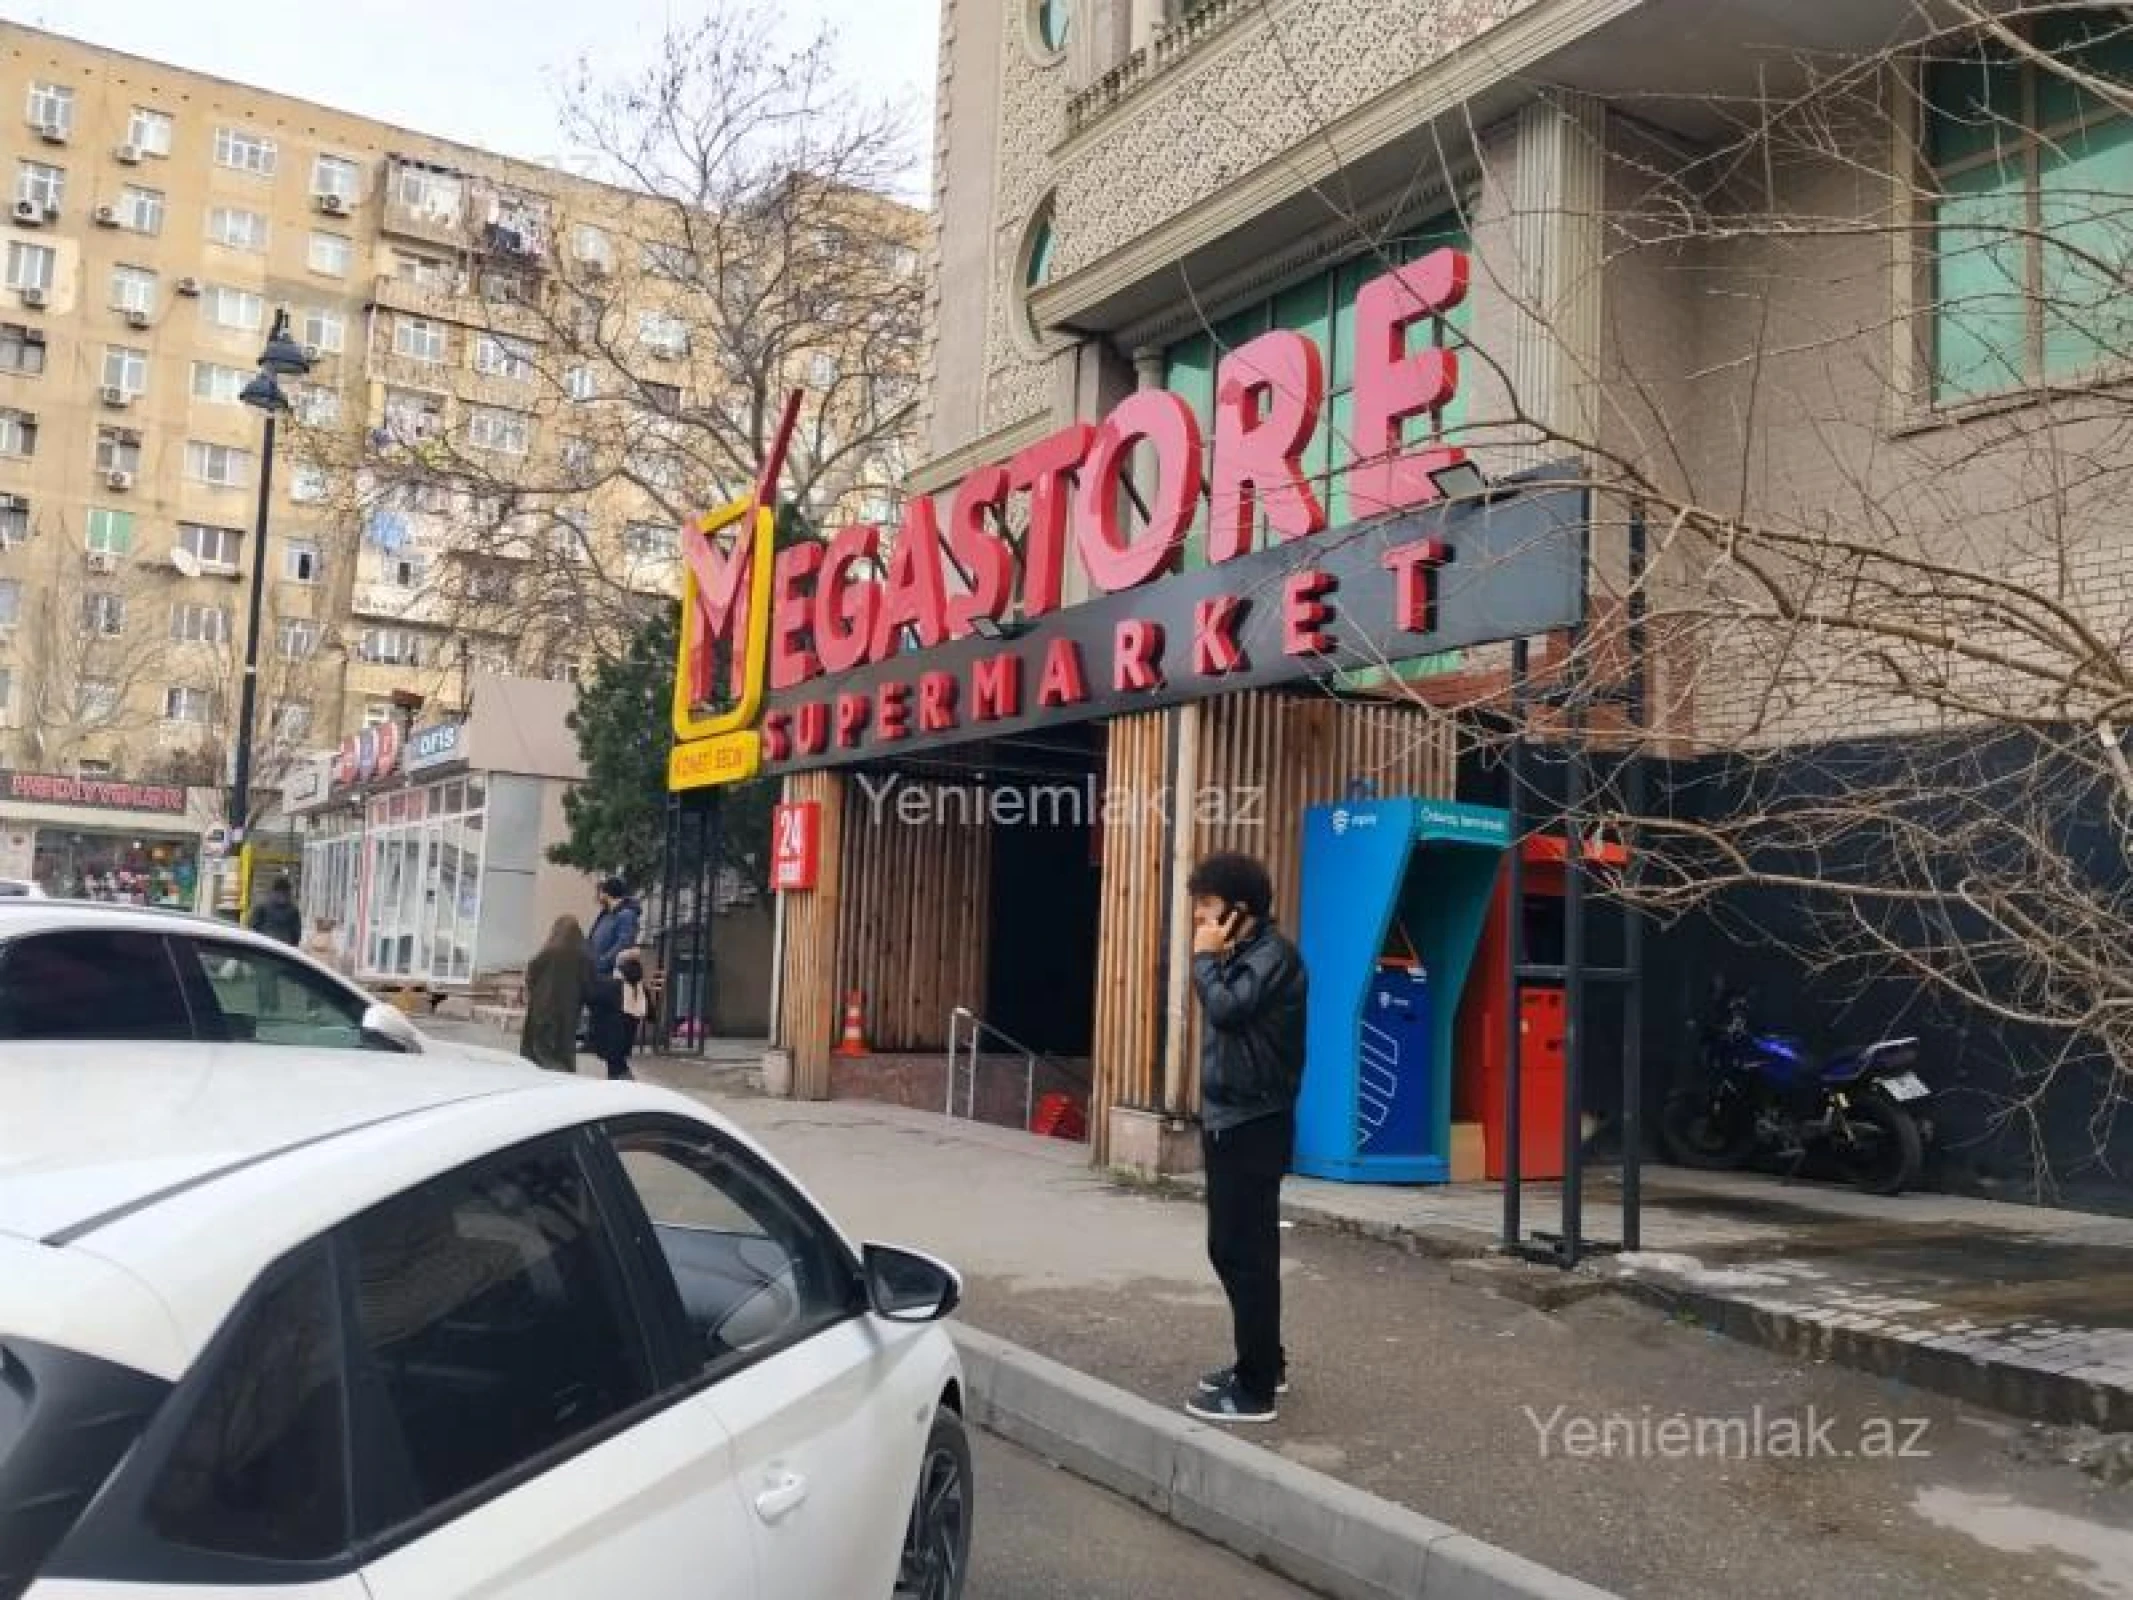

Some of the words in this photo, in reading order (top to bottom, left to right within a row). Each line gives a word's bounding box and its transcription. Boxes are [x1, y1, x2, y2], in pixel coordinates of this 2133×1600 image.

[680, 247, 1470, 705] MEGASTORE
[762, 537, 1455, 760] SUPERMARKET
[780, 810, 803, 856] 24
